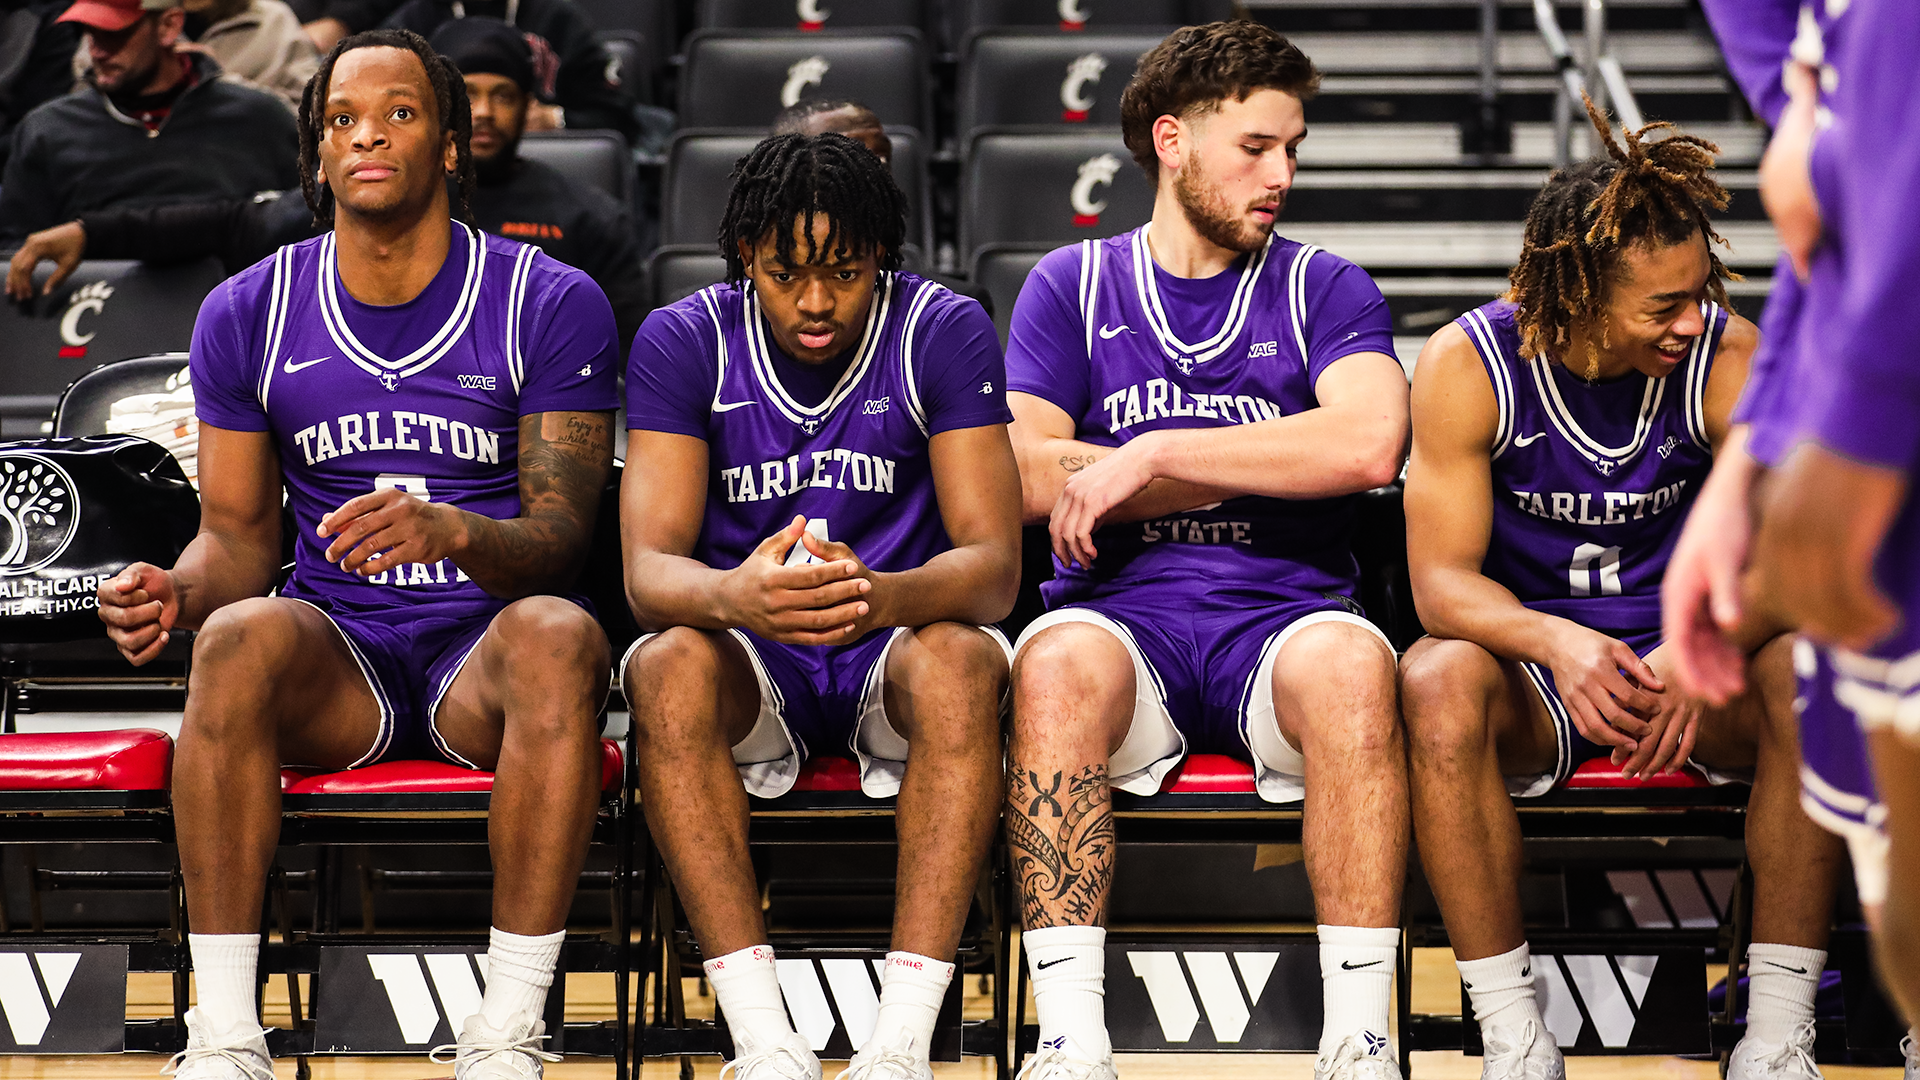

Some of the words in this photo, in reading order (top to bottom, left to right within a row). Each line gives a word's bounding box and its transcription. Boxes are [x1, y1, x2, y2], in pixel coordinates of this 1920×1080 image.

[457, 374, 496, 391] WAC
[294, 411, 500, 466] TARLETON
[557, 431, 588, 446] while
[567, 416, 594, 436] Enjoy
[721, 448, 895, 503] TARLETON
[1512, 480, 1687, 525] TARLETON
[1141, 518, 1252, 545] STATE
